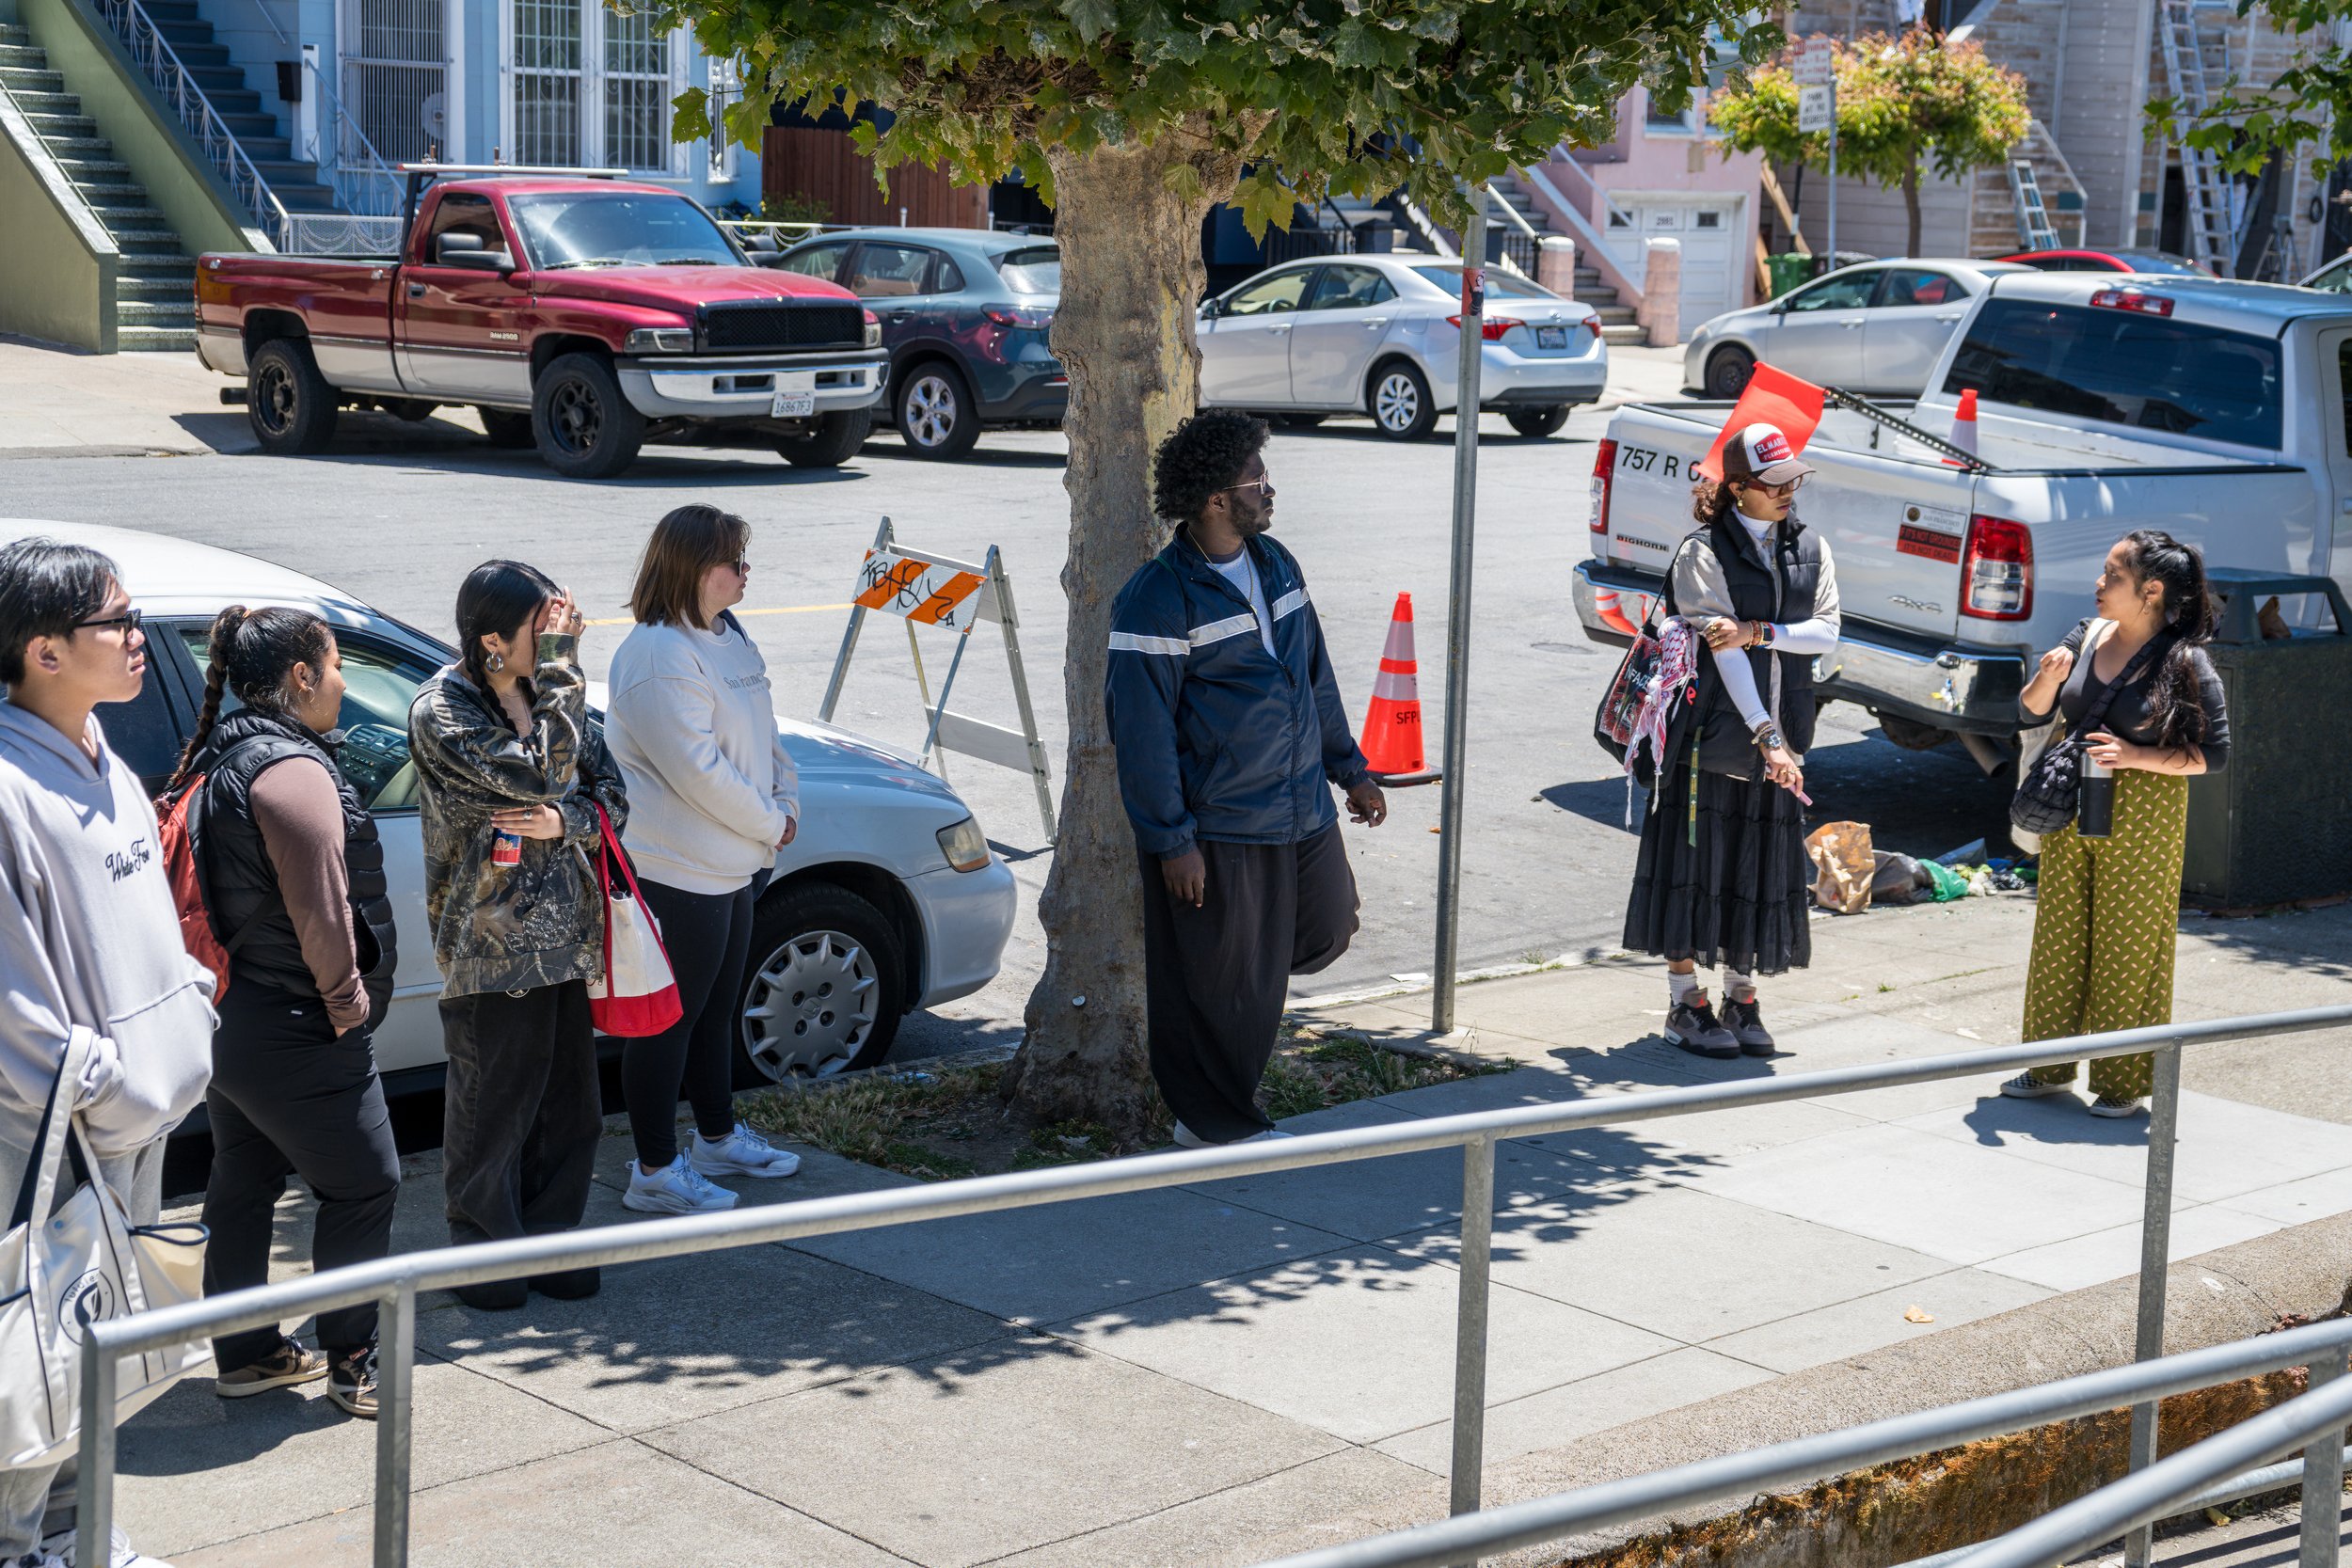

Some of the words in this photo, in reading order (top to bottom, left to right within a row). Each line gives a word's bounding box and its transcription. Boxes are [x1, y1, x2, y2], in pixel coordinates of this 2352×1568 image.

[1756, 443, 1768, 453] EL
[1622, 446, 1658, 472] 757
[1663, 455, 1679, 478] R
[1616, 533, 1669, 552] BIGHORN
[1917, 531, 1930, 543] NOT
[1918, 546, 1931, 557] NOT
[1933, 548, 1954, 561] DEAD
